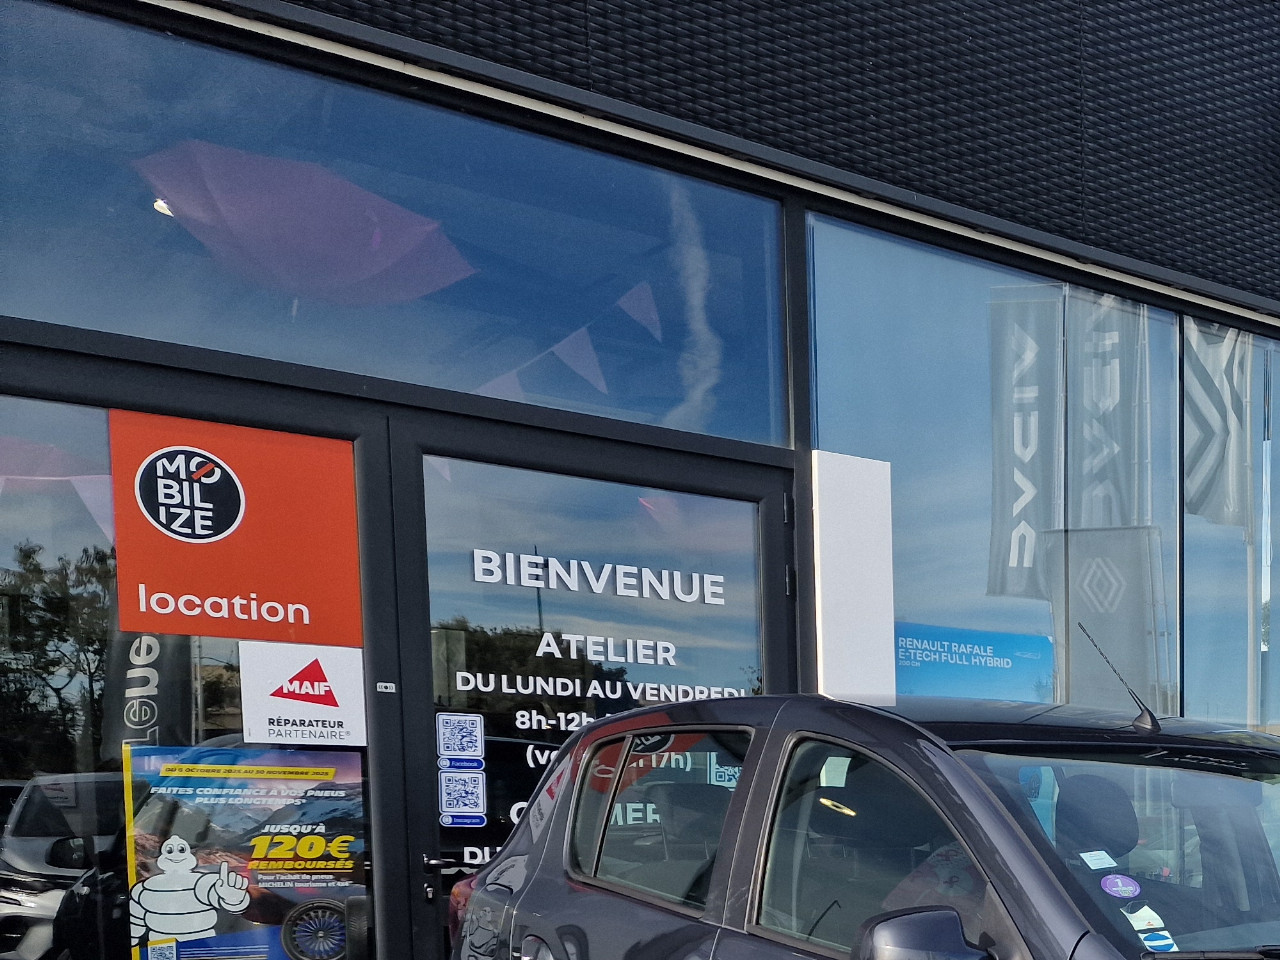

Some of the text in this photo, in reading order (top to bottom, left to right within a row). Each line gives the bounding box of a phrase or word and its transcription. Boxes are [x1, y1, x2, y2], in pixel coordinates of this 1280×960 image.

[473, 548, 725, 605] BIENVENUE
[138, 583, 310, 625] location
[535, 632, 677, 666] ATELIER
[898, 637, 994, 656] RENAULT RAFALE
[898, 649, 1012, 669] E-TECH FULL HYBRID
[281, 680, 331, 696] MAIF
[455, 671, 496, 692] DU
[501, 675, 582, 697] LUNDI
[586, 680, 622, 699] AU
[267, 716, 345, 729] RÉPARATEUR
[150, 786, 194, 795] FAITES
[195, 787, 267, 796] CONFIANCE
[280, 789, 306, 797] VOS
[194, 796, 227, 804] PLUS
[261, 823, 326, 836] JUSQU'À
[249, 834, 356, 859] 120€
[247, 859, 355, 870] REMBOURSÉS
[258, 880, 294, 888] MICHELIN
